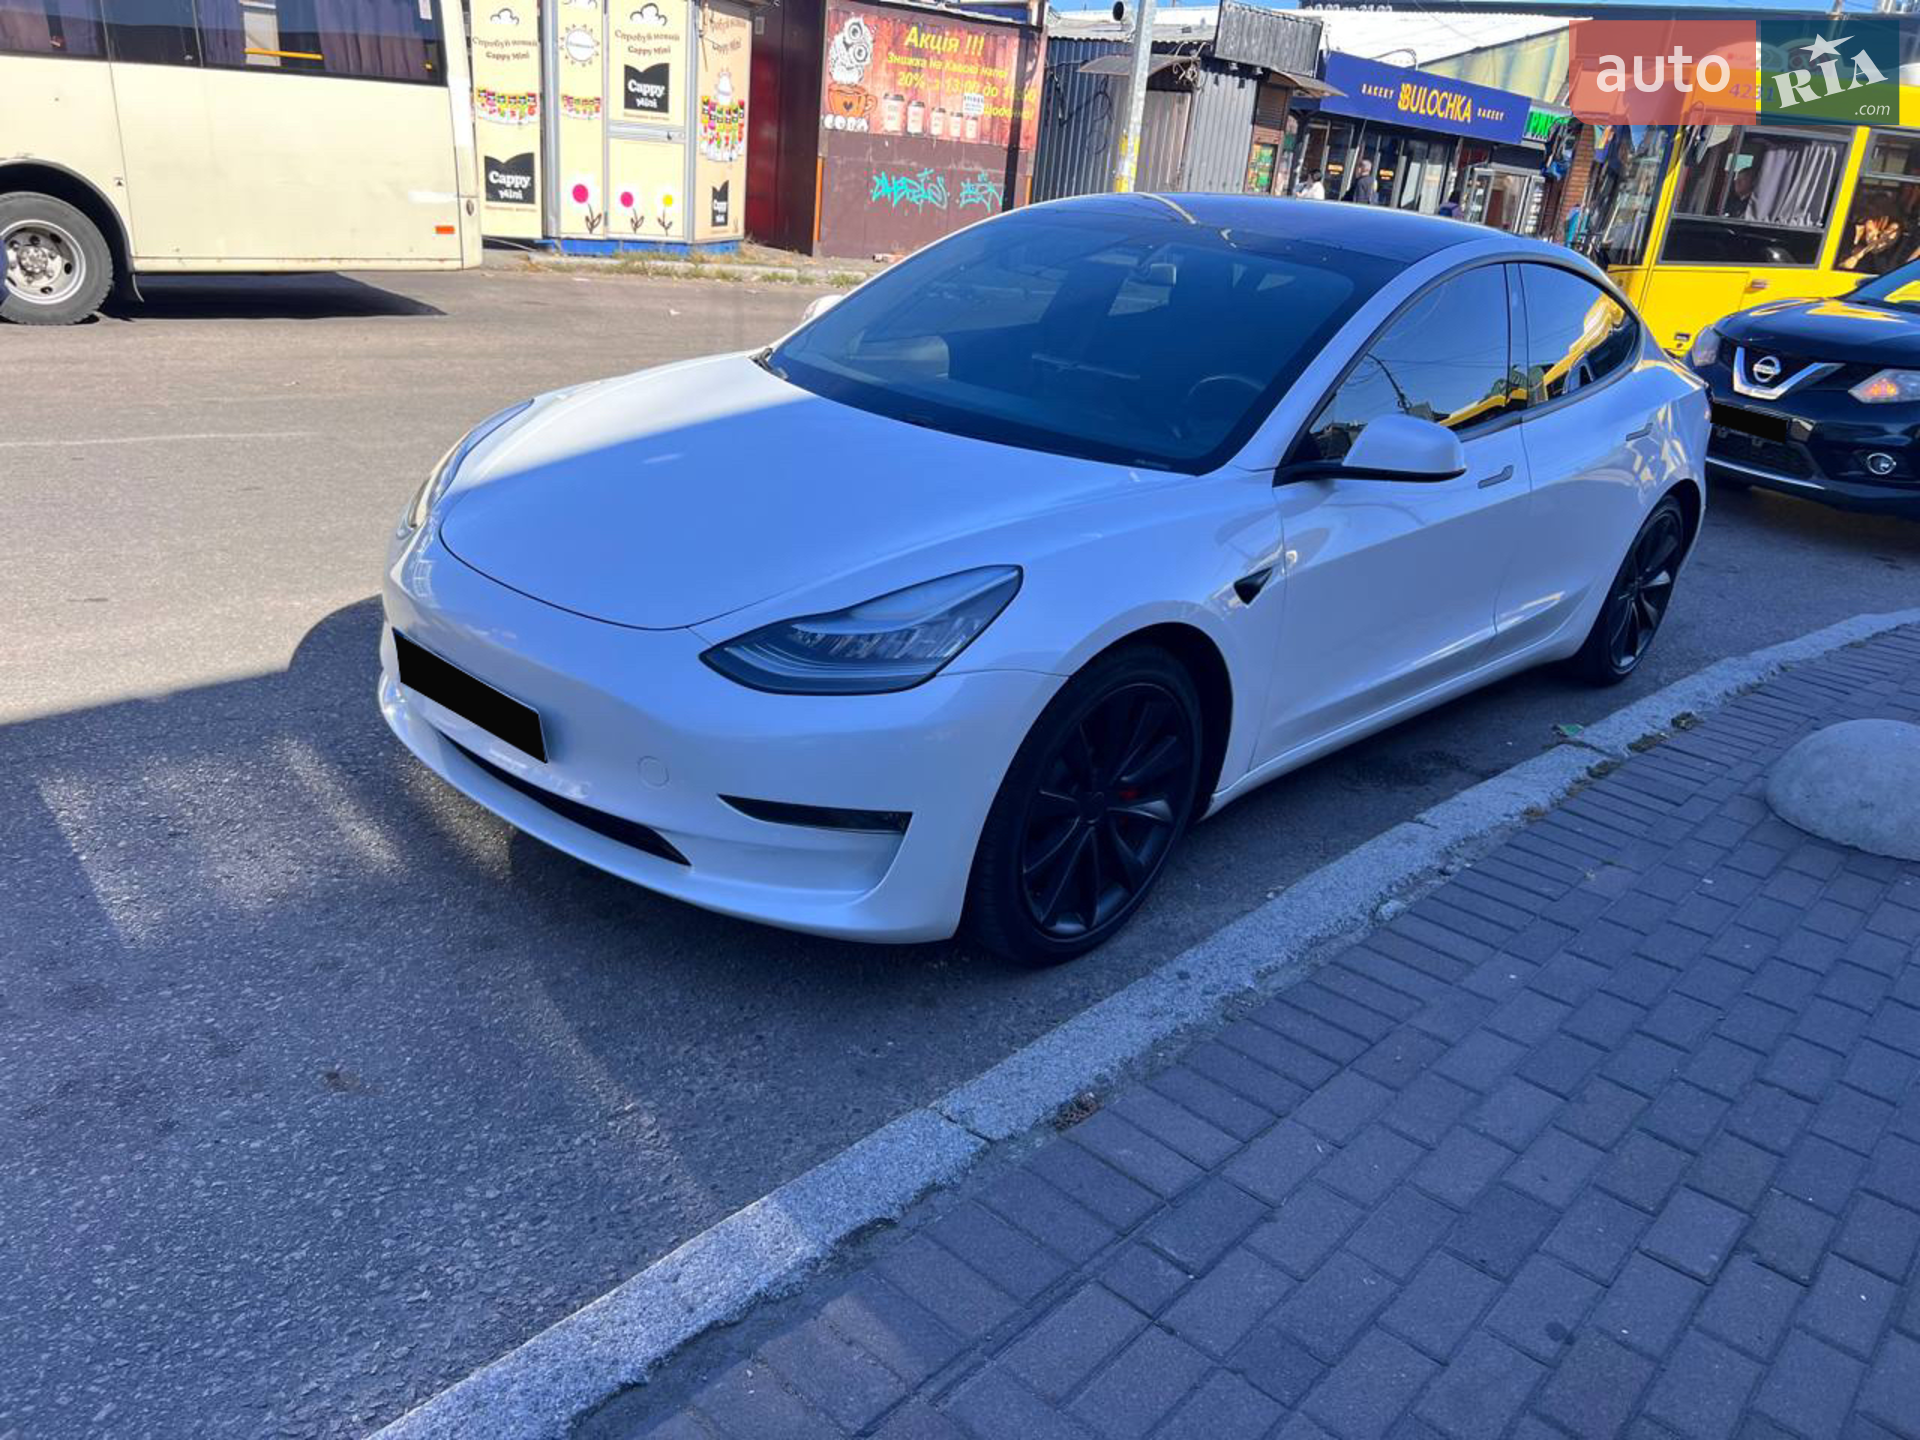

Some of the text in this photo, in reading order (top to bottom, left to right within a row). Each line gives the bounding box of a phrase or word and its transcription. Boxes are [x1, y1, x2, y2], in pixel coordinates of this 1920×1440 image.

[905, 26, 960, 54] Акція
[485, 51, 511, 60] Cappy
[627, 79, 665, 98] Cappy
[636, 97, 657, 108] Mini
[1361, 83, 1505, 123] BAKERY BULOCHKA BAKERY
[488, 170, 532, 189] Cappy
[498, 189, 523, 200] Mini
